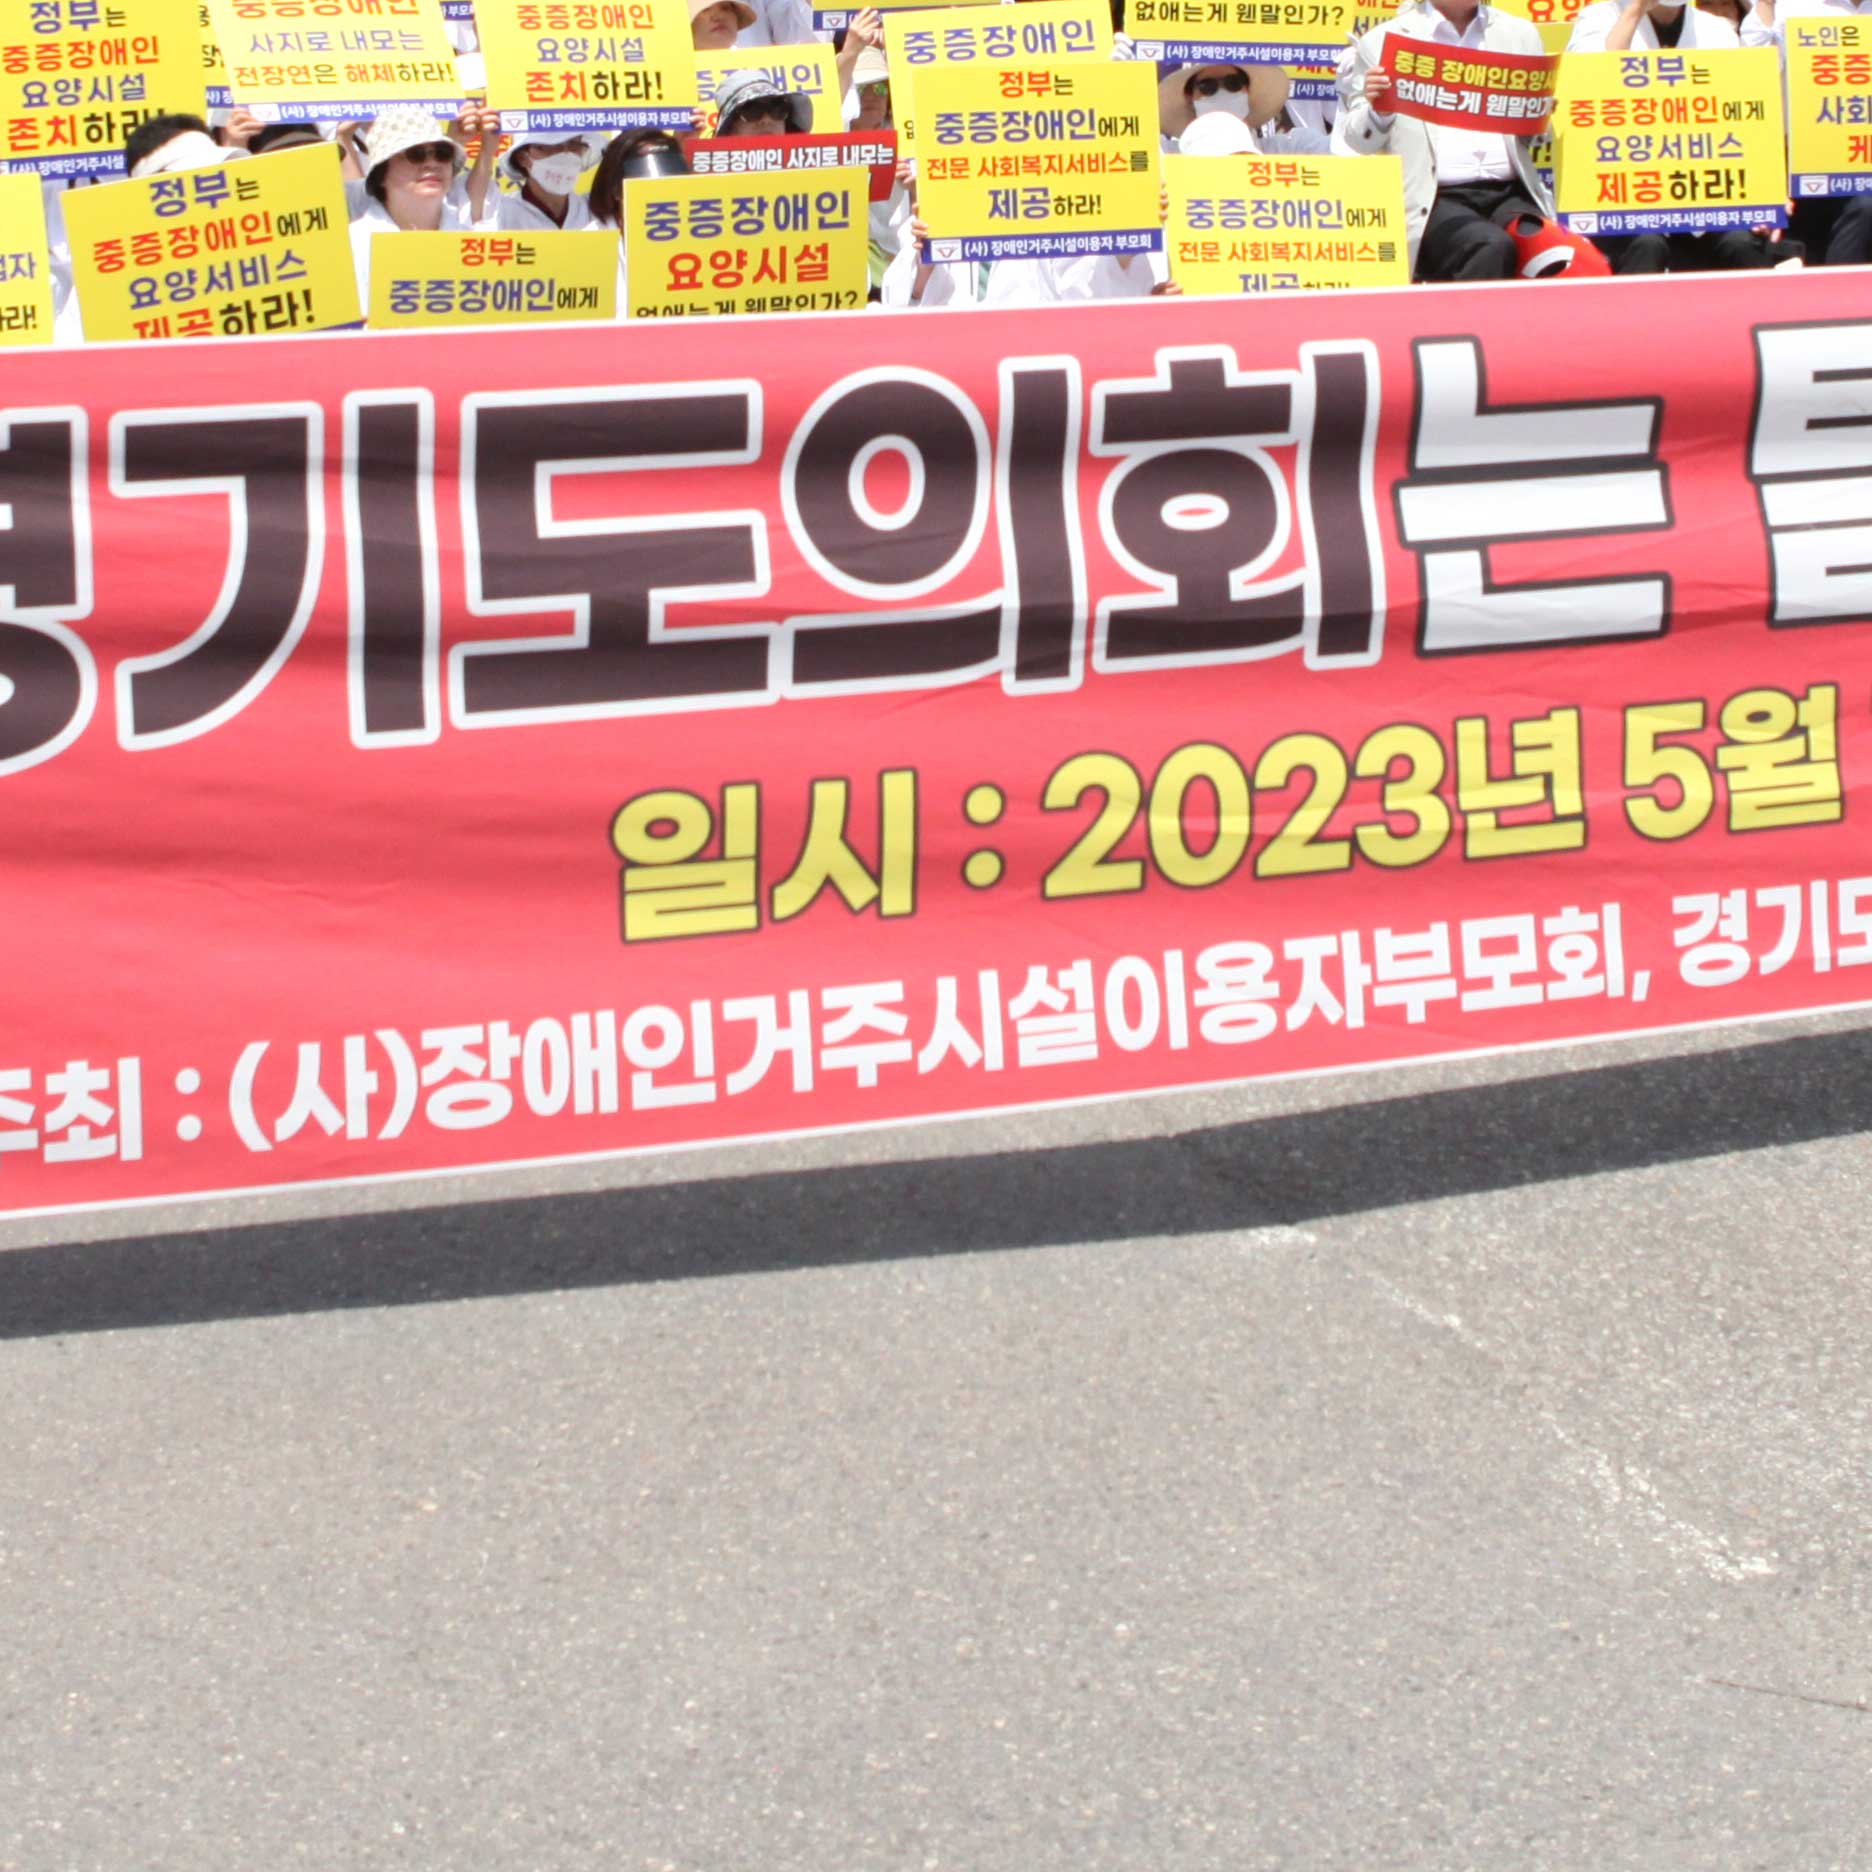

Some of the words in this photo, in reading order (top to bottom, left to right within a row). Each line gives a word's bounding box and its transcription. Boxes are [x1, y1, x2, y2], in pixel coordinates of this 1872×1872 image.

[1, 36, 160, 74] 중증장애인
[903, 19, 1096, 65] 중증장애인
[999, 70, 1073, 98] 정부는
[1619, 56, 1711, 88] 정부는
[935, 108, 1140, 145] 중증장애인에게
[1569, 96, 1765, 129] 중증장애인에게
[927, 156, 970, 181] 전문
[978, 150, 1149, 178] 사회복지서비스를
[1595, 133, 1744, 163] 요양서비스
[988, 187, 1102, 220] 제공하라!
[1596, 168, 1747, 205] 제공하라!
[644, 190, 850, 243] 중증장애인
[1185, 199, 1387, 231] 중증장애인에게
[93, 207, 328, 274] 중증장애인에게
[1228, 241, 1397, 263] 사회복지서비스를
[129, 248, 307, 310] 요양서비스
[666, 242, 830, 292] 요양시설
[389, 278, 599, 316] 중증장애인에게
[610, 766, 916, 947] 일시
[1040, 706, 1586, 900] 2023년
[1623, 680, 1845, 843] 5월
